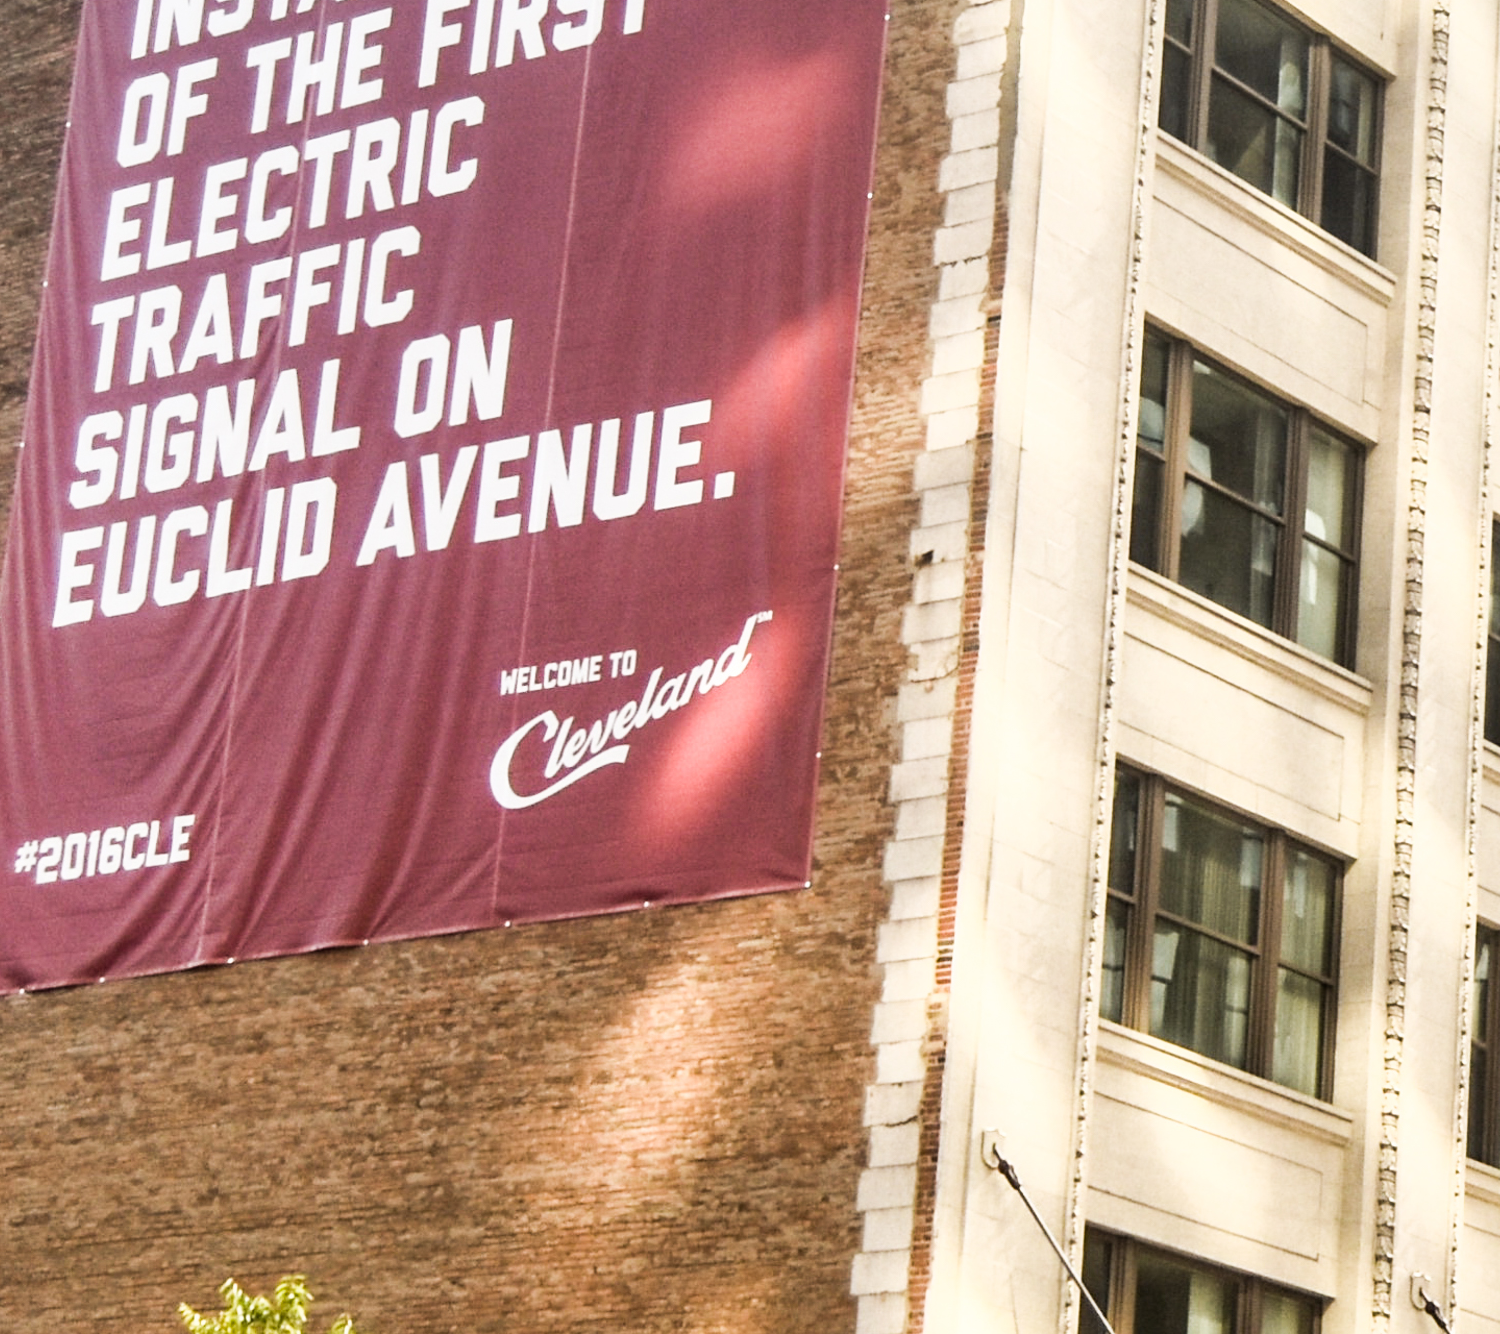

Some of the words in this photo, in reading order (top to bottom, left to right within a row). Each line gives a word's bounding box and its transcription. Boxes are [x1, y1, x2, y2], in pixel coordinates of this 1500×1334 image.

[114, 55, 220, 170] OF
[244, 5, 395, 136] THE
[98, 93, 487, 284] ELECTRIC
[88, 223, 423, 395] TRAFFIC
[66, 356, 363, 512] SIGNAL
[391, 316, 515, 440] ON
[49, 474, 339, 630] EUCLID
[353, 397, 737, 569] AVENUE.
[489, 613, 759, 810] Cleveland
[500, 654, 604, 696] WELCOME
[608, 648, 638, 679] TO
[13, 813, 197, 885] #2016CLE
